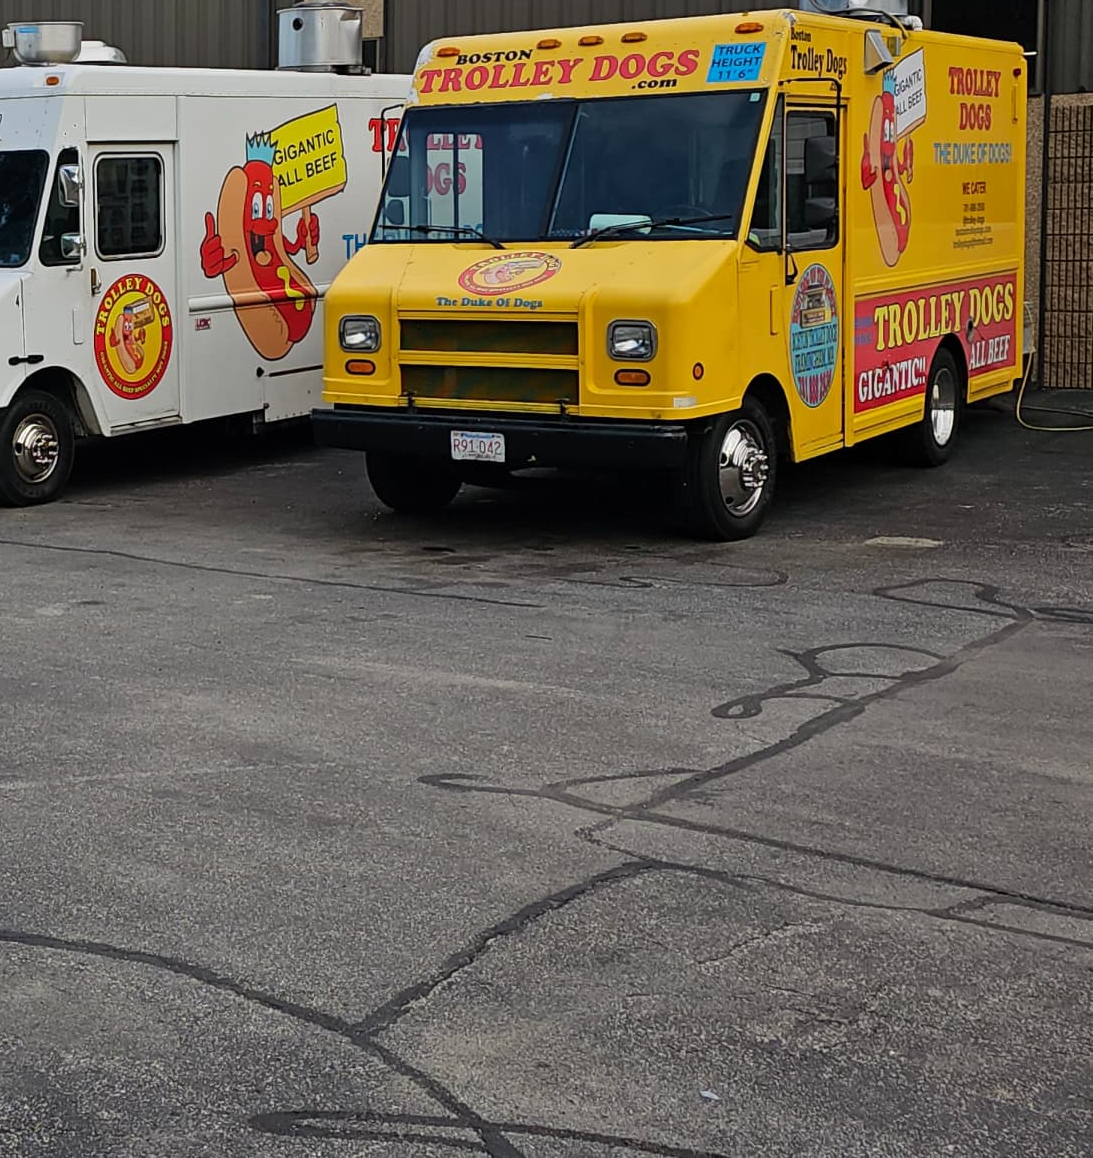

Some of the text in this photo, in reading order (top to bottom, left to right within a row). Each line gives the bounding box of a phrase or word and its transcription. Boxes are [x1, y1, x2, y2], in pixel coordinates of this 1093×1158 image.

[456, 49, 533, 66] BOSTON
[711, 56, 763, 68] HEIGHT
[718, 44, 763, 56] TRUCK
[790, 45, 848, 80] Trolley Dogs
[419, 50, 701, 93] TROLLEY DOGS
[631, 78, 677, 91] .com
[894, 69, 922, 97] GIGANTIC
[948, 67, 1001, 98] TROLLEY
[896, 88, 923, 116] ALL BEEF
[959, 103, 992, 130] DOGS
[274, 129, 334, 165] GIGANTIC
[933, 143, 951, 164] THE
[953, 143, 976, 164] DUKE
[977, 143, 987, 164] OF
[279, 151, 338, 188] ALL BEEF
[97, 277, 170, 335] TROLLEY DOGS
[436, 297, 458, 306] The
[461, 297, 493, 307] Duke
[514, 298, 543, 310] Dogs
[873, 290, 966, 351] TROLLEY
[969, 282, 1014, 329] DOGS
[969, 335, 1011, 371] ALL BEEF
[858, 356, 926, 403] GIGANTIC!!
